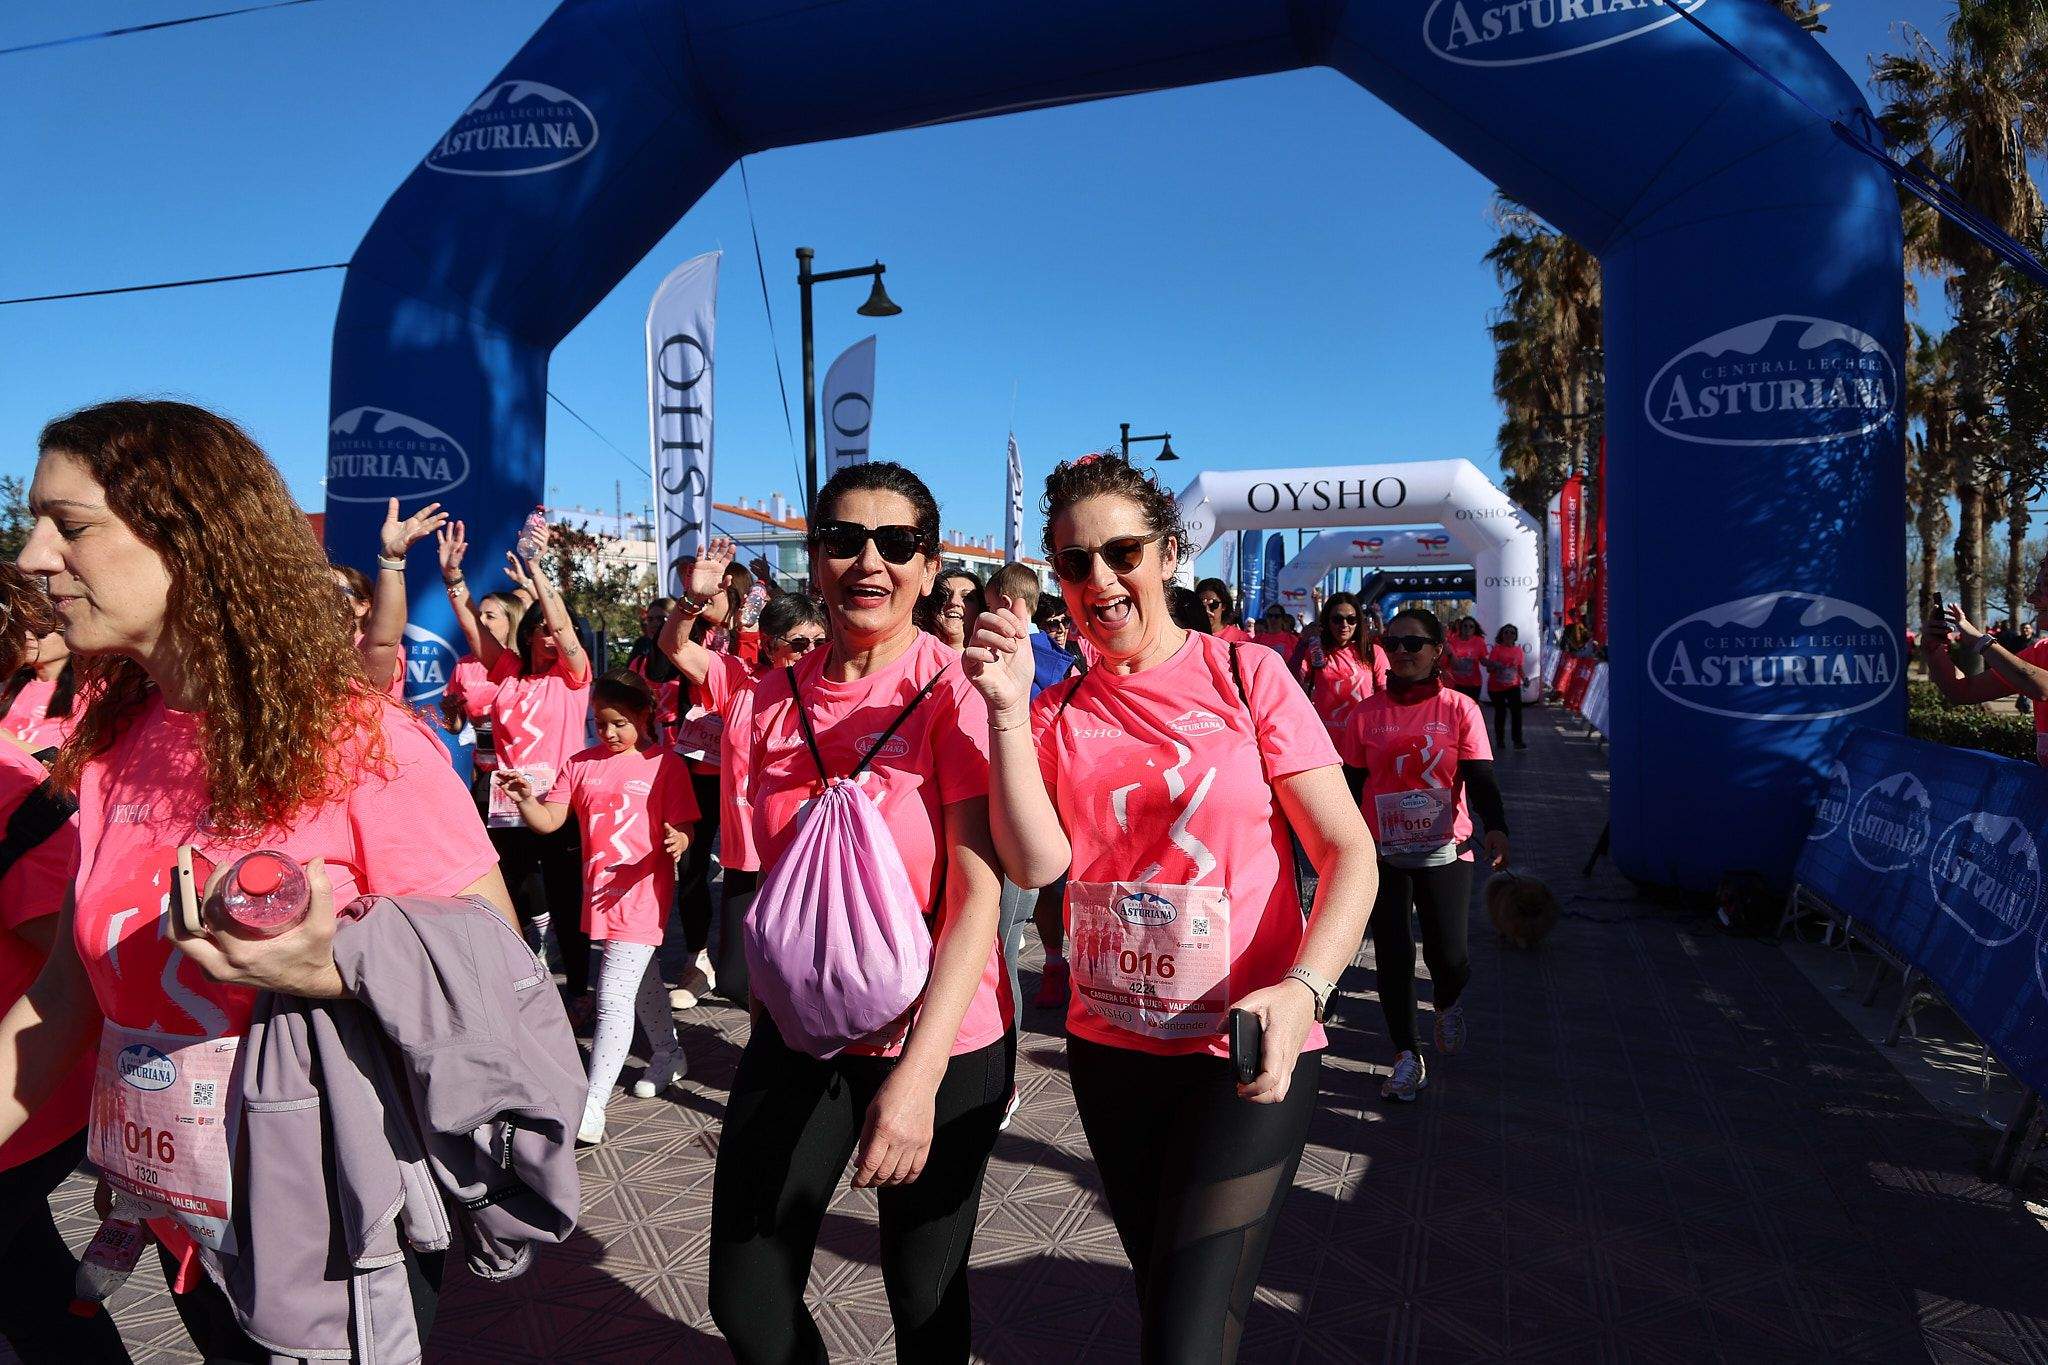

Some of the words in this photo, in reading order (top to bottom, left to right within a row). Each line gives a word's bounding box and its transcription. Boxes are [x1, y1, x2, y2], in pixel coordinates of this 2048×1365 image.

[1702, 359, 1798, 379] CENTRAL
[1807, 355, 1884, 371] LECHERA
[1661, 374, 1887, 423] ASTURIANA
[329, 453, 454, 481] STURIANA
[1247, 476, 1407, 513] OYSHO
[1455, 508, 1507, 521] OYSHO
[1567, 496, 1577, 567] Santander
[1394, 577, 1463, 585] VOLVO
[1484, 575, 1533, 588] OYSHO
[1704, 635, 1799, 649] CENTRAL
[1808, 633, 1885, 647] LECHERA
[1664, 640, 1891, 687] ASTURIANA
[1073, 728, 1122, 739] YSHO
[1404, 818, 1432, 831] 016
[1119, 904, 1173, 920] ASTURIANA
[1119, 950, 1176, 979] 016
[1129, 982, 1156, 996] 4224
[1169, 1002, 1206, 1012] VALENCIA
[1159, 1021, 1207, 1031] Santander
[119, 1057, 171, 1083] ASTURIANA
[124, 1121, 175, 1164] 016
[135, 1165, 158, 1185] 1320
[170, 1196, 209, 1213] VALENCIA
